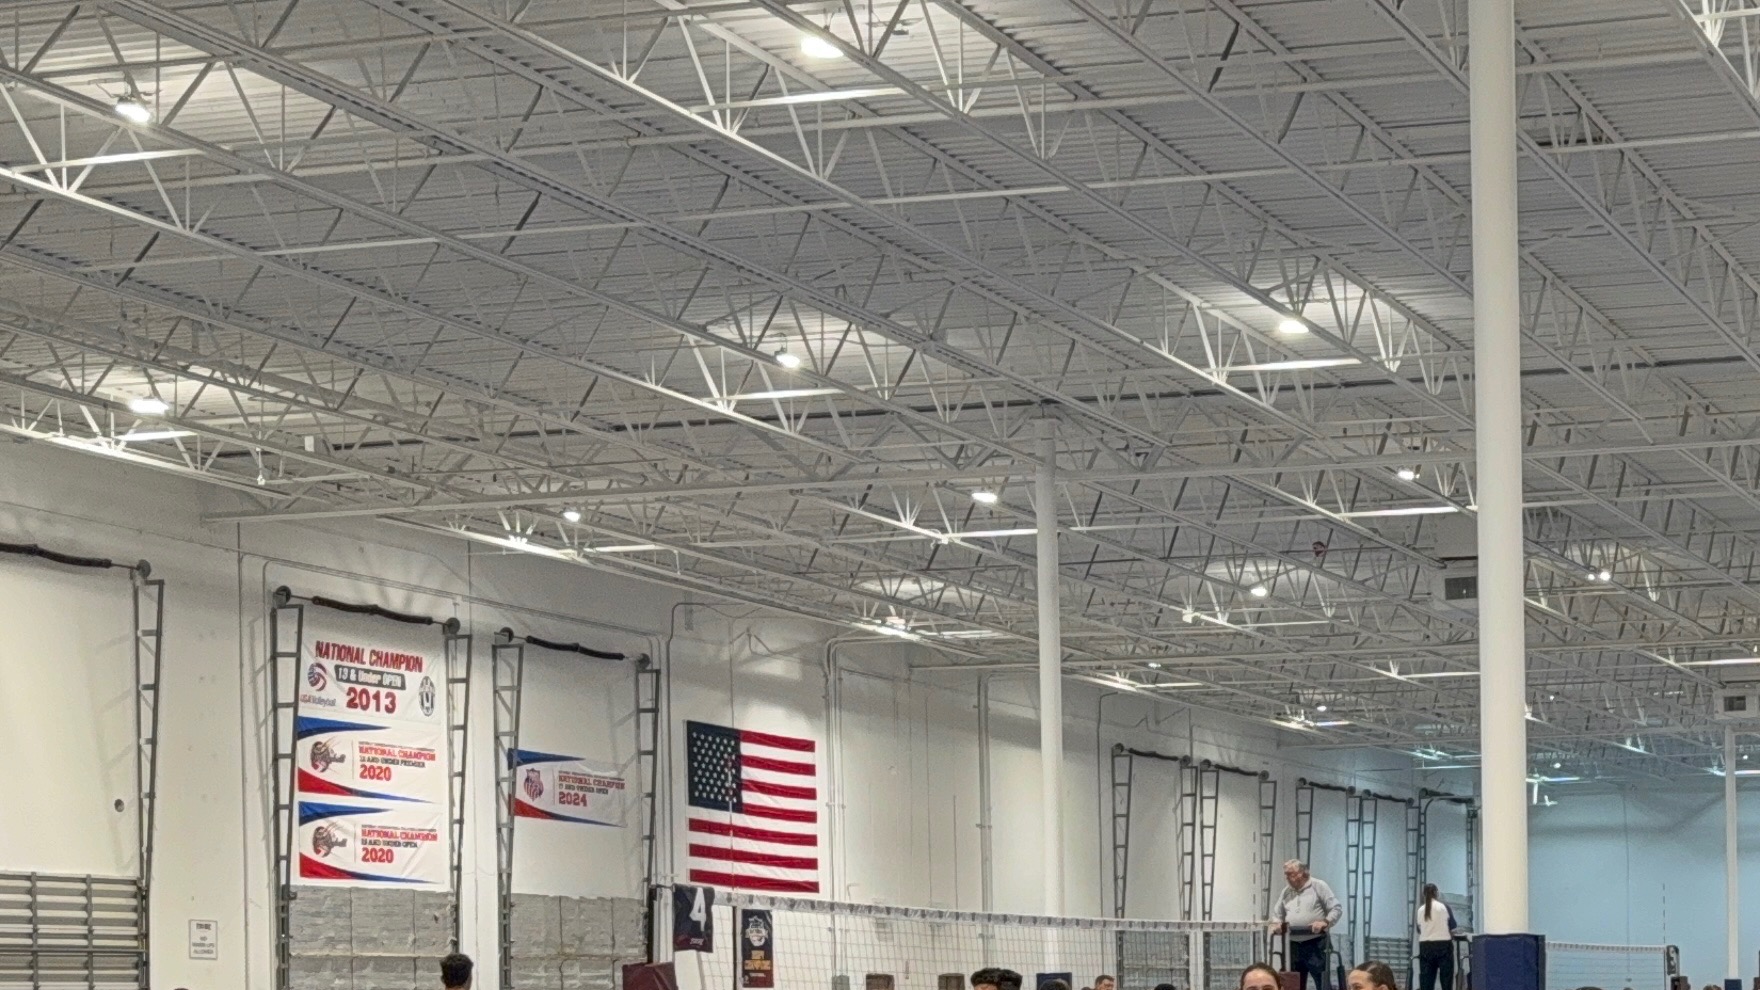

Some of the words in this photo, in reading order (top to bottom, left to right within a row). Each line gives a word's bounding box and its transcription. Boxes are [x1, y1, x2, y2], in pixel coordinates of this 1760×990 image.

[315, 640, 367, 666] NATIONAL
[369, 649, 423, 673] CHAMPION
[346, 686, 397, 714] 2013
[358, 745, 397, 757] NATIONAL
[398, 749, 436, 761] CHAMPION
[359, 764, 392, 781] 2020
[558, 791, 588, 807] 2024
[361, 828, 399, 839] NATIONAL
[400, 831, 437, 841] CHAMPION
[361, 846, 394, 863] 2020
[689, 887, 707, 931] 4
